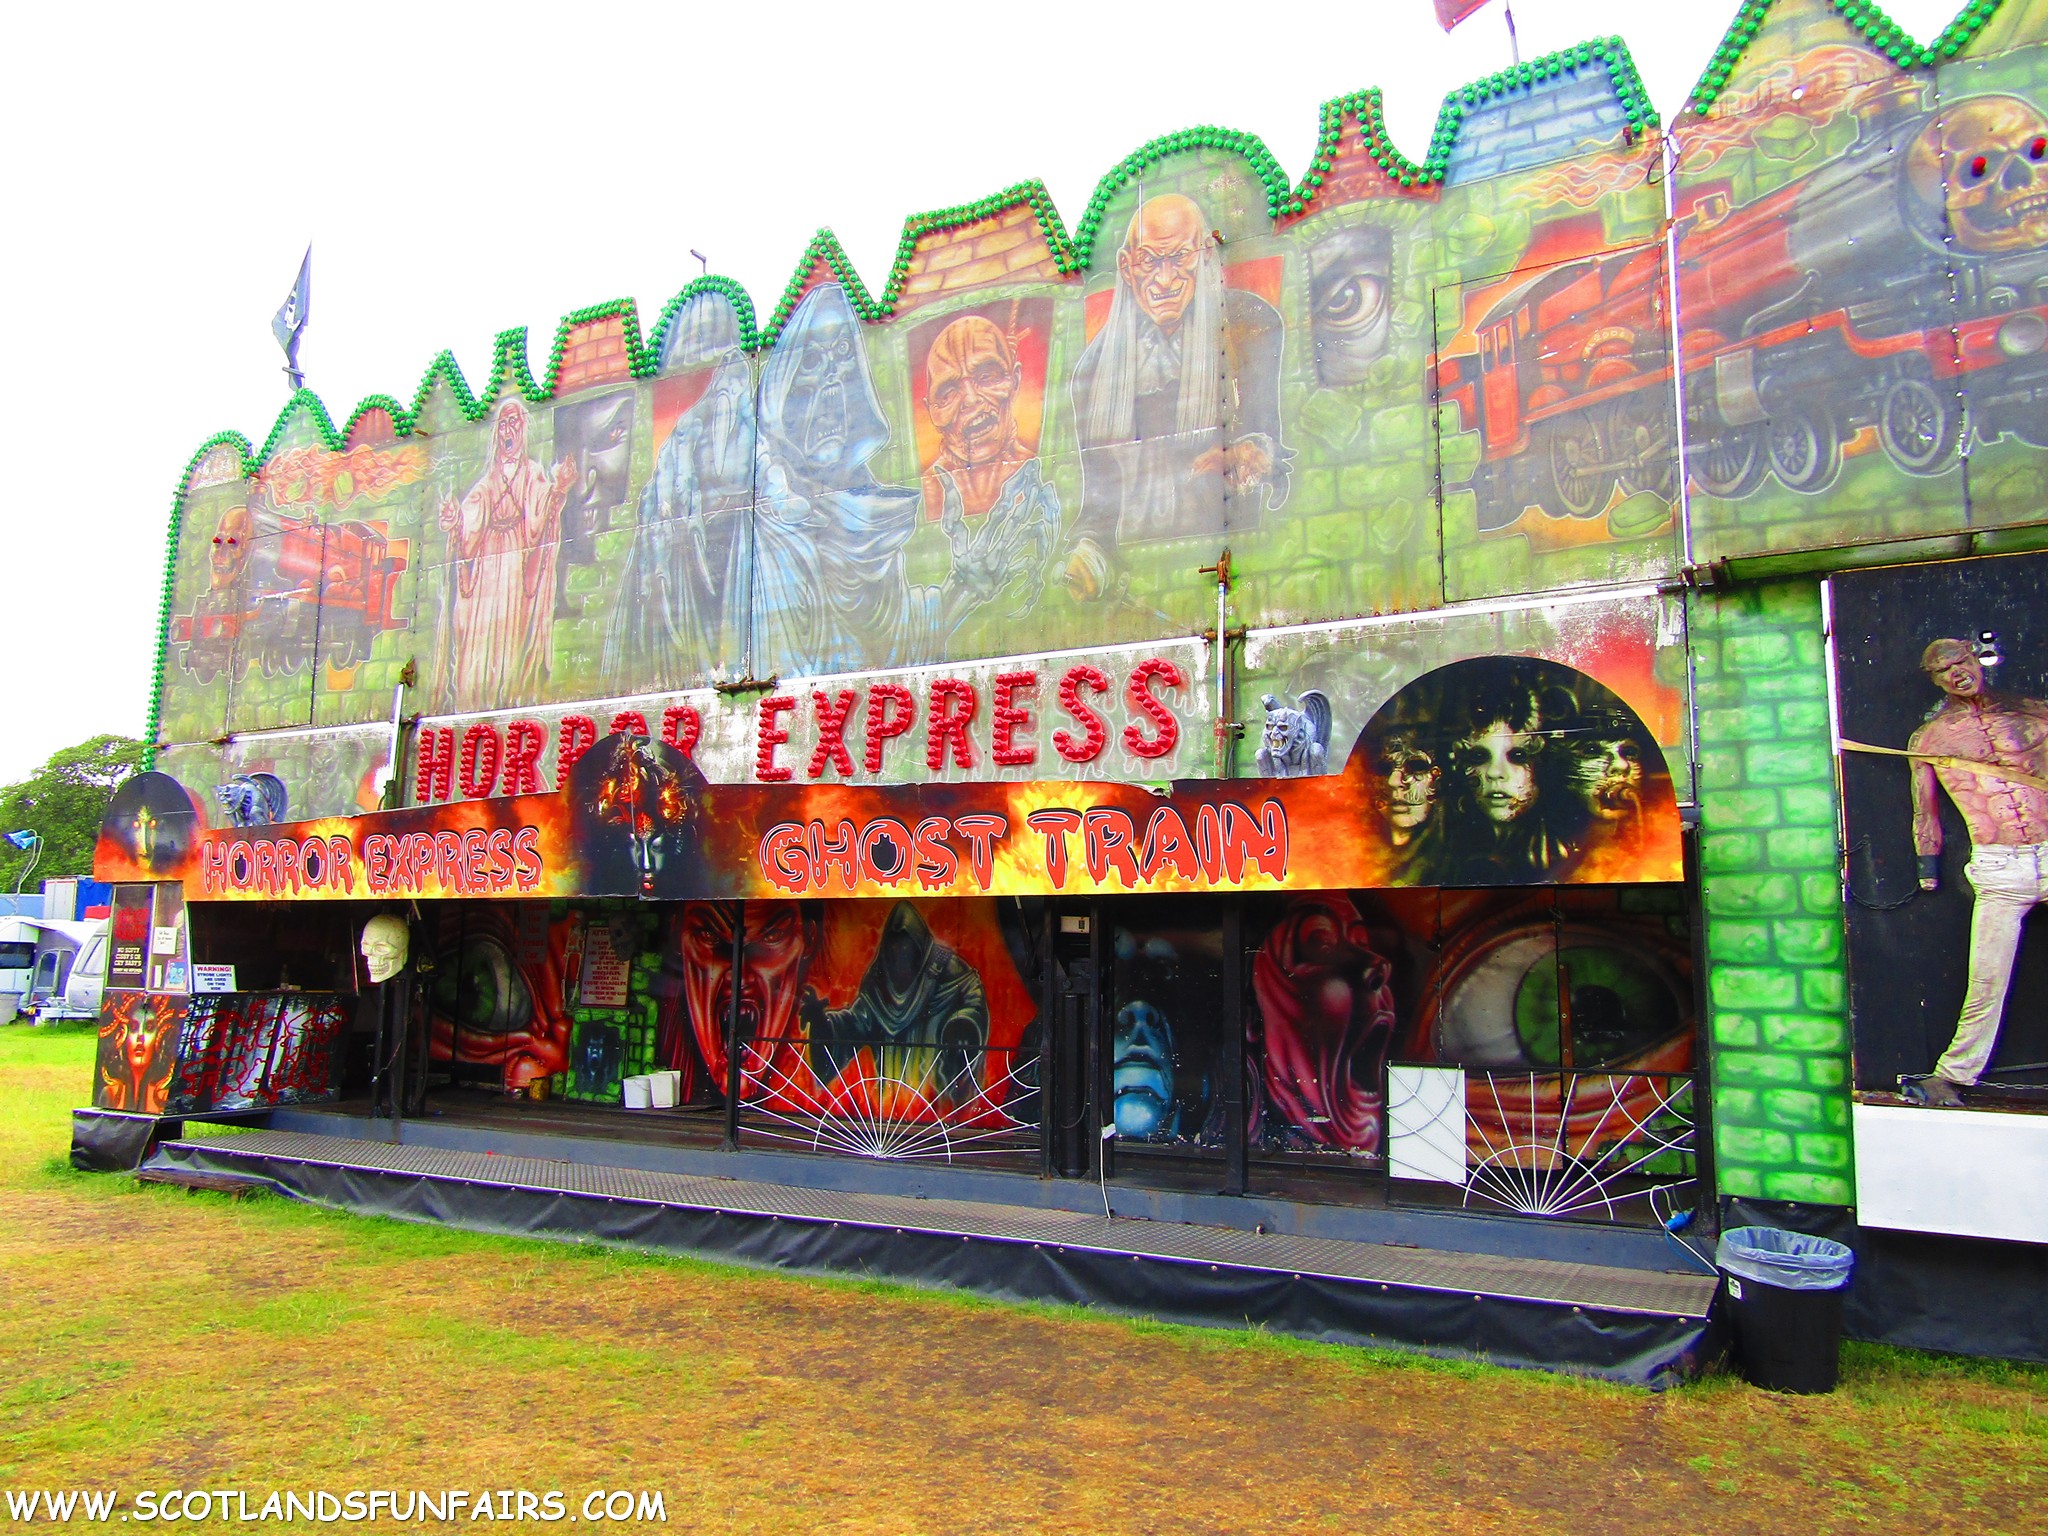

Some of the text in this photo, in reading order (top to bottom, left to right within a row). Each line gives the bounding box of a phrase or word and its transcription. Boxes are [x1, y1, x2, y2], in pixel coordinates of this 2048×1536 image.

[756, 657, 1183, 783] EXPRESS
[203, 826, 543, 895] HORROR EXPRESS
[758, 798, 1290, 893] GHOST TRAIN
